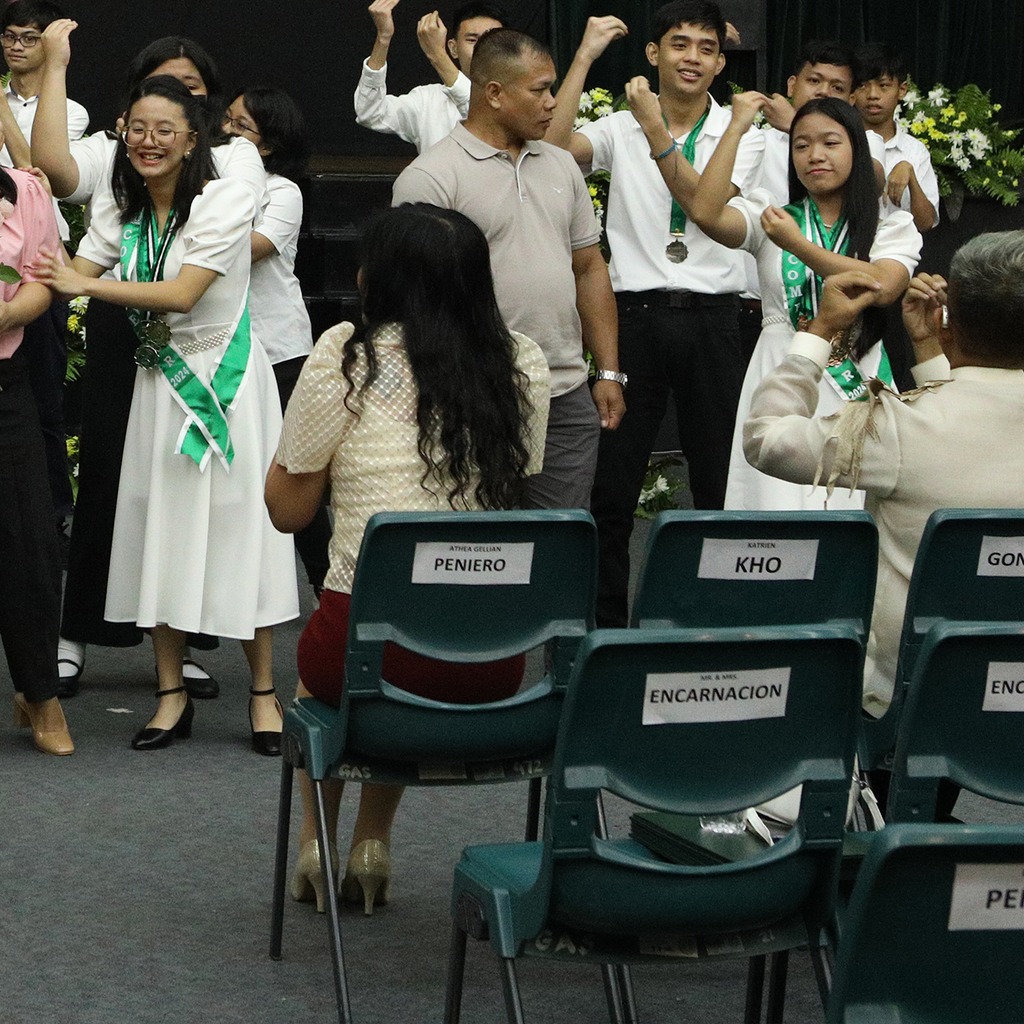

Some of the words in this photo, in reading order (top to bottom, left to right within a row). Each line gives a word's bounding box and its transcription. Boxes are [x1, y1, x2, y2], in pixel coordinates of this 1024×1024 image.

[170, 367, 190, 388] 2024
[434, 558, 507, 572] PENIERO
[735, 557, 782, 574] KHO
[650, 683, 782, 704] ENCARNACION
[985, 889, 1024, 909] PE
